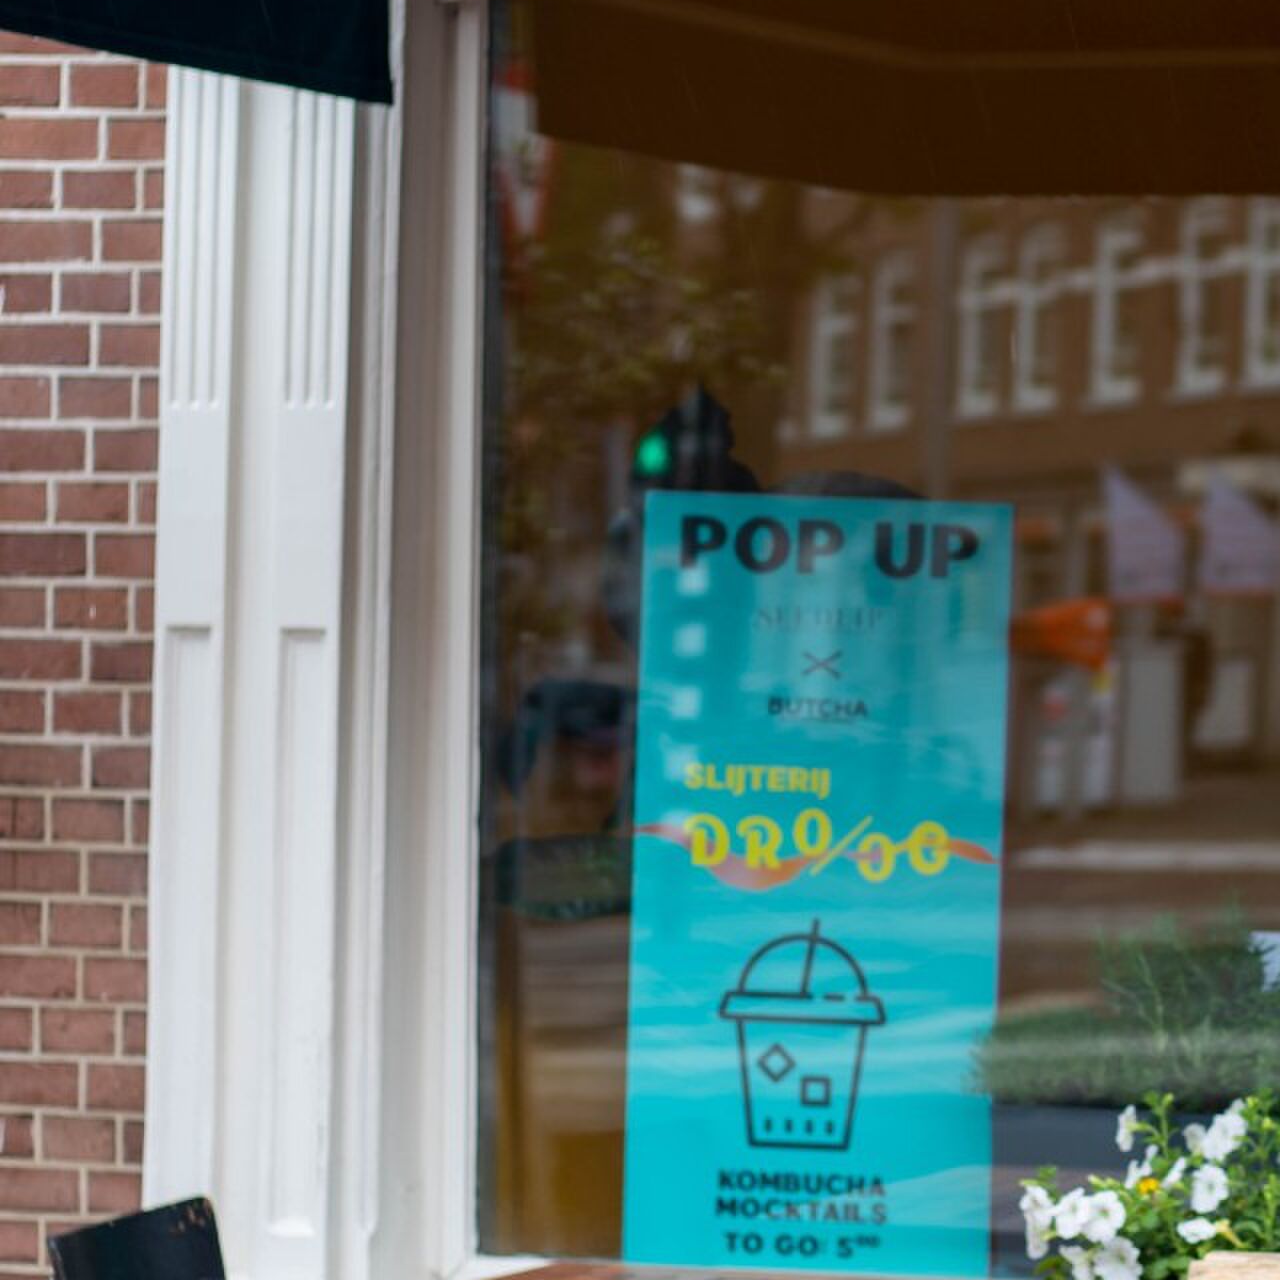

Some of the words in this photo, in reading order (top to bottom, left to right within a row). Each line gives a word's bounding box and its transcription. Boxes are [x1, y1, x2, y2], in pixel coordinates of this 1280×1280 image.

[681, 516, 844, 574] POP
[874, 522, 979, 579] UP
[683, 763, 831, 799] SLIJTERIJ
[718, 1170, 885, 1197] KOMBUCHA
[716, 1196, 888, 1224] MOCKTAILS
[725, 1231, 763, 1254] TO
